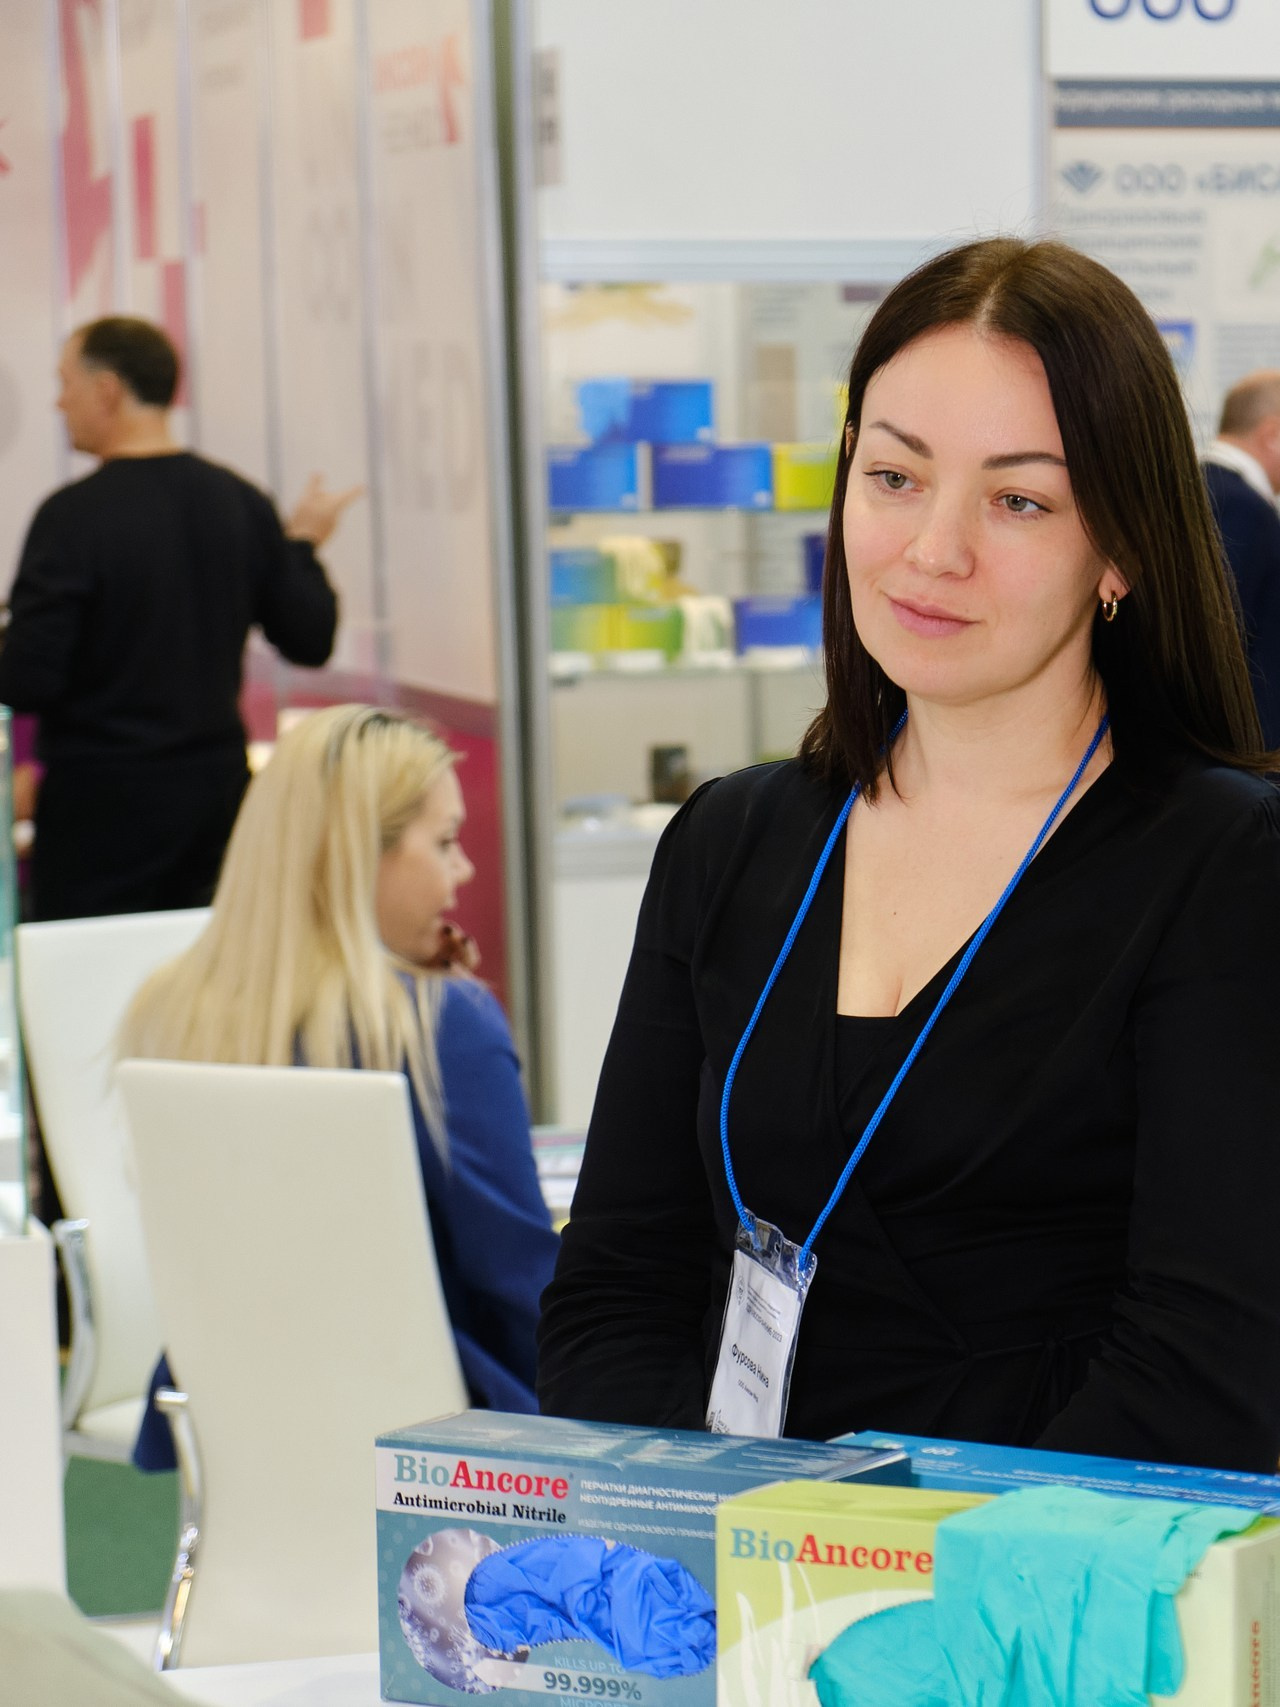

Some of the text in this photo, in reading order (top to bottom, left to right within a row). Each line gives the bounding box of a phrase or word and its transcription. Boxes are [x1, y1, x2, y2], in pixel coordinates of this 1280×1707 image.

[1116, 163, 1184, 193] ООО
[732, 1343, 757, 1375] Фурсова
[394, 1454, 569, 1500] BioAncore
[580, 1480, 626, 1494] ПЕРЧАТКИ
[627, 1485, 717, 1502] ДИАГНОСТИЧЕСКИЕ
[393, 1492, 567, 1525] Antimicrobial Nitrile
[580, 1493, 655, 1511] НЕОПУДРЕННЫЕ
[614, 1521, 677, 1535] ОДНОРАЗОВОГО
[730, 1528, 934, 1574] BioAncore
[554, 1655, 587, 1669] KILLS
[589, 1660, 607, 1672] UP
[543, 1671, 642, 1701] 99.999%
